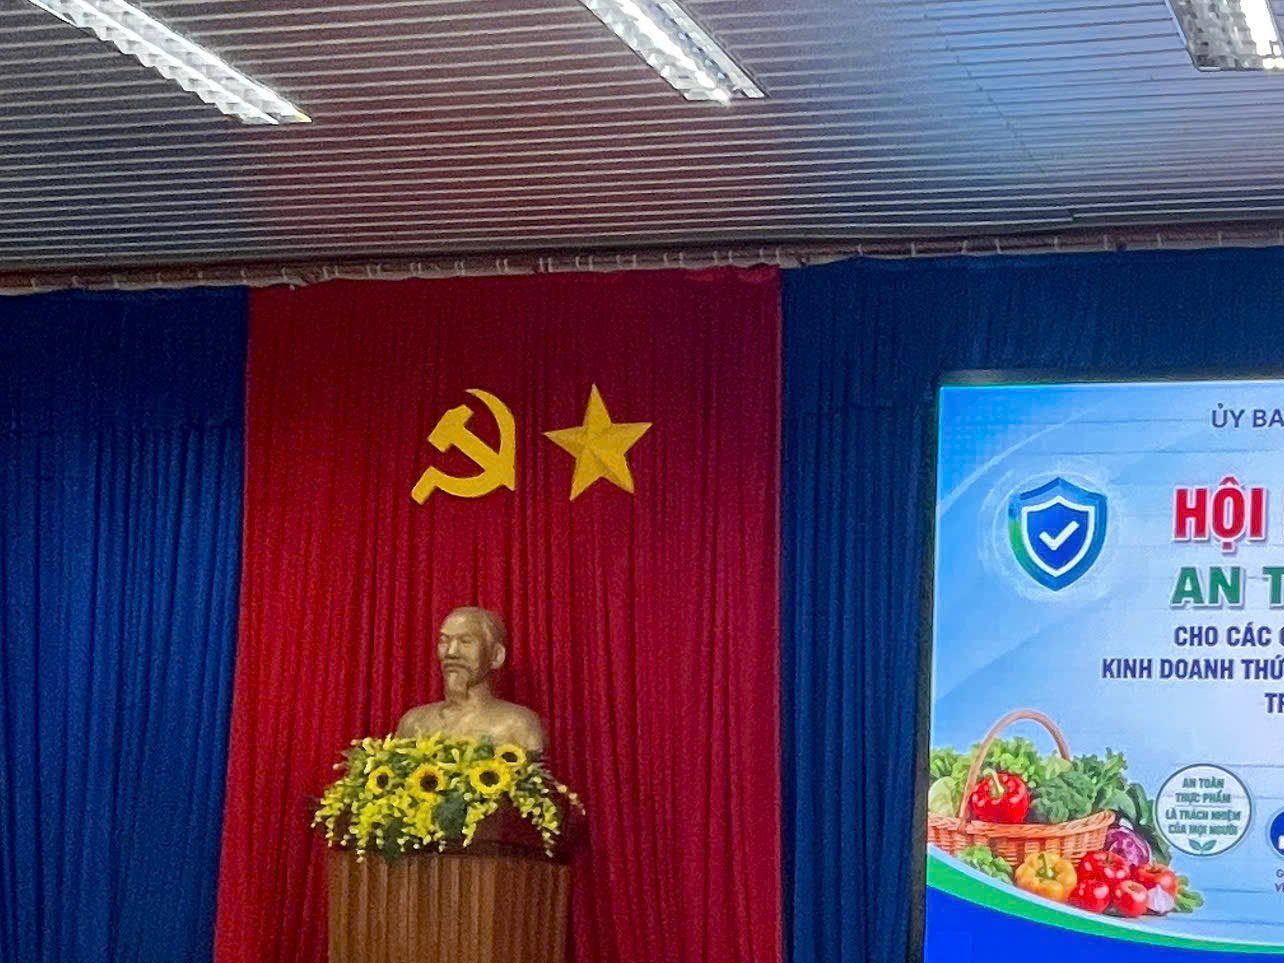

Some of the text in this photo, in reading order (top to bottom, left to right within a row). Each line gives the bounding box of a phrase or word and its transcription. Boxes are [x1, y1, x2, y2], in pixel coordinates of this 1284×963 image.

[1212, 403, 1245, 428] ỦY
[1174, 476, 1264, 551] HỘI
[1171, 566, 1242, 605] AN
[1174, 626, 1218, 647] CHO
[1226, 622, 1272, 647] CÁC
[1102, 658, 1152, 679] KINH
[1160, 658, 1234, 680] DOANH
